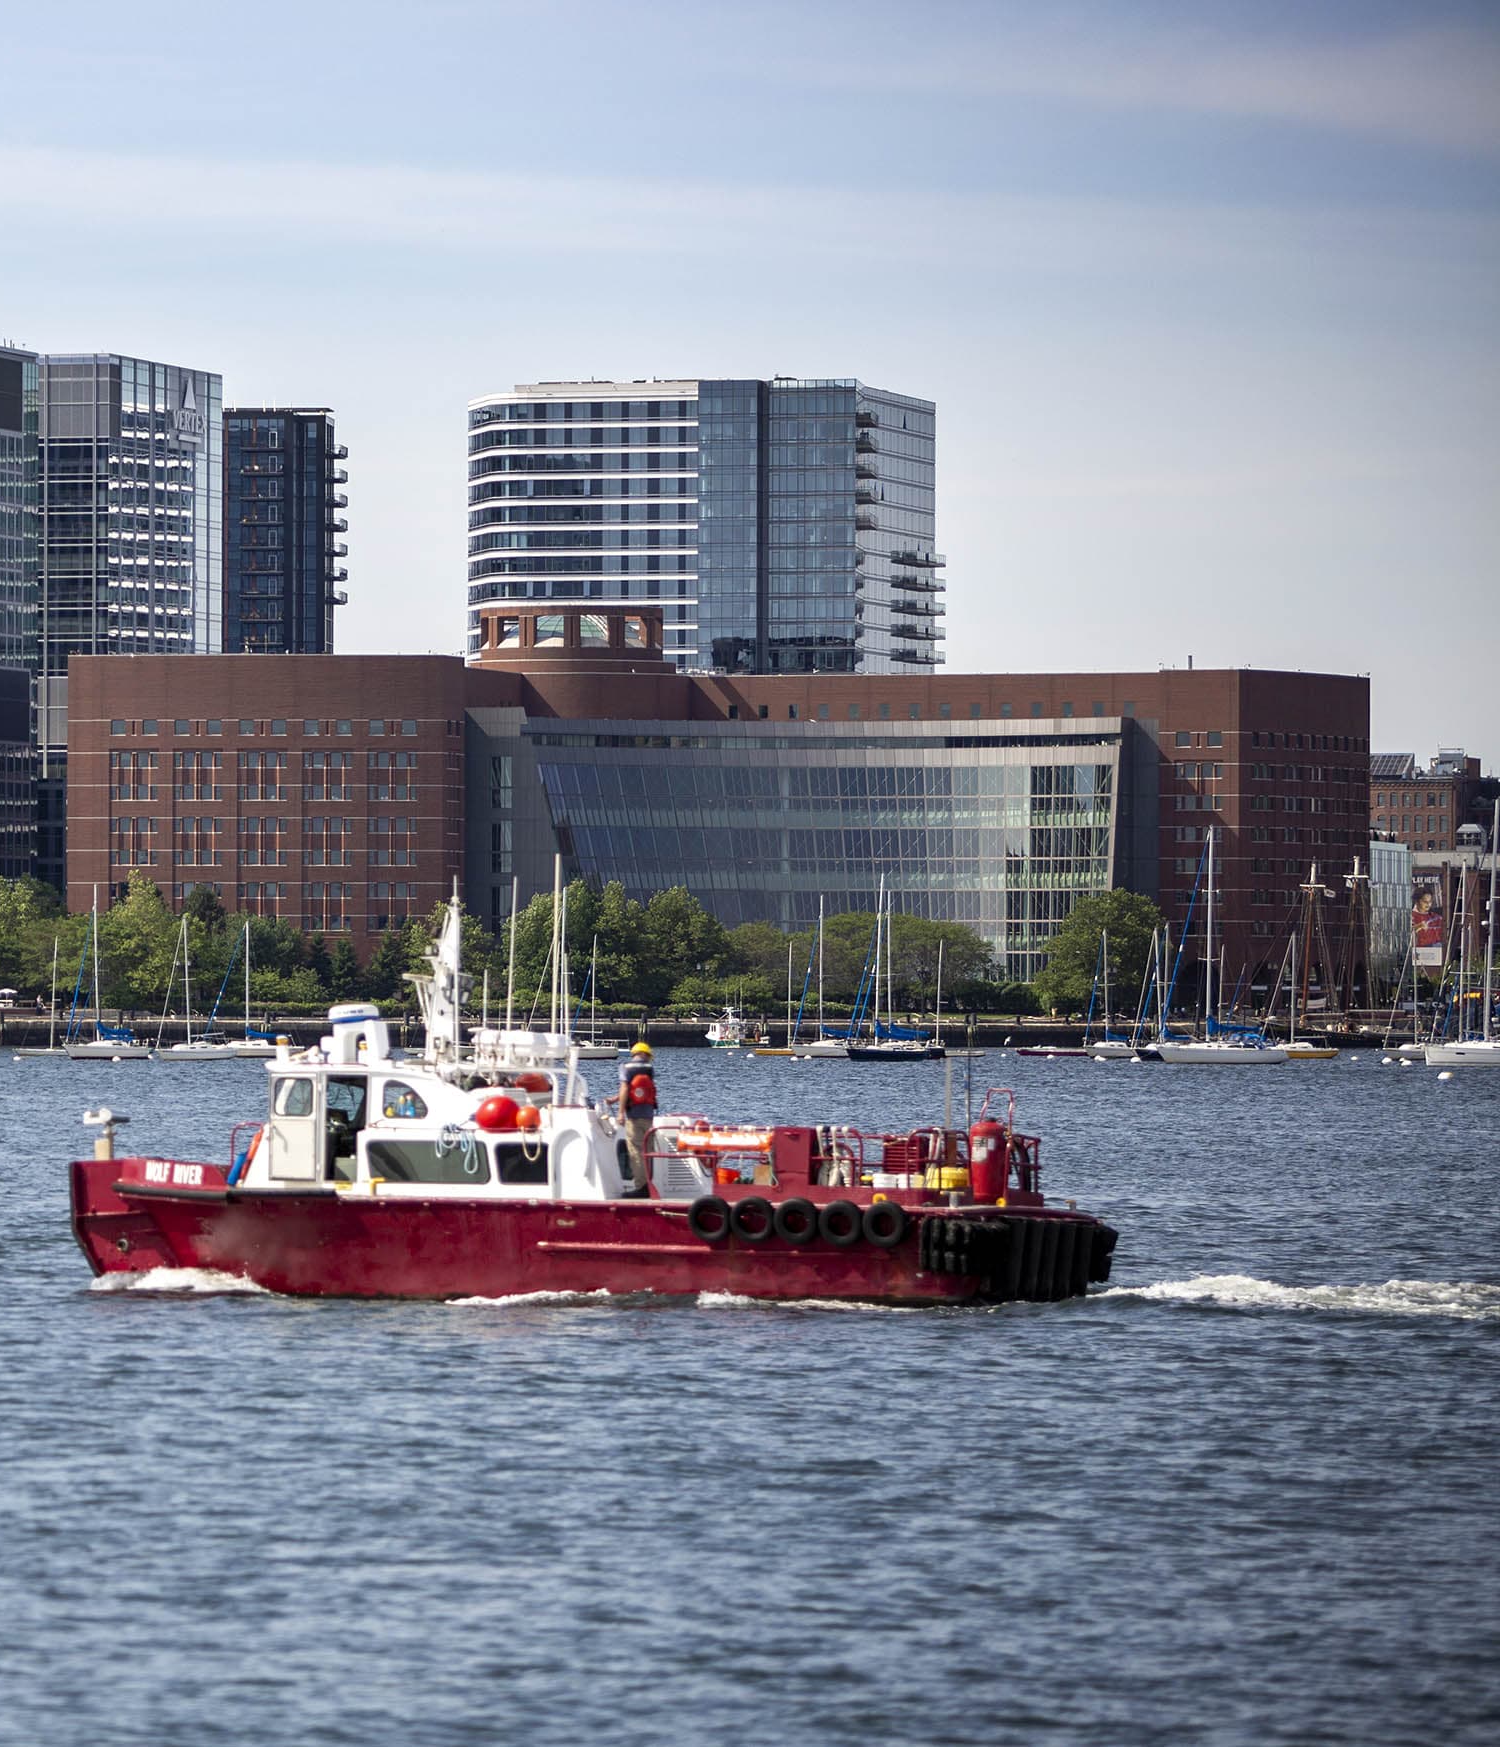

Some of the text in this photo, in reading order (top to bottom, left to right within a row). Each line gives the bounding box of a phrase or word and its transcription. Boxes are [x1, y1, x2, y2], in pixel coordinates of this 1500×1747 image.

[173, 409, 207, 434] VERTEX
[145, 1161, 202, 1184] WOLF RIVER
